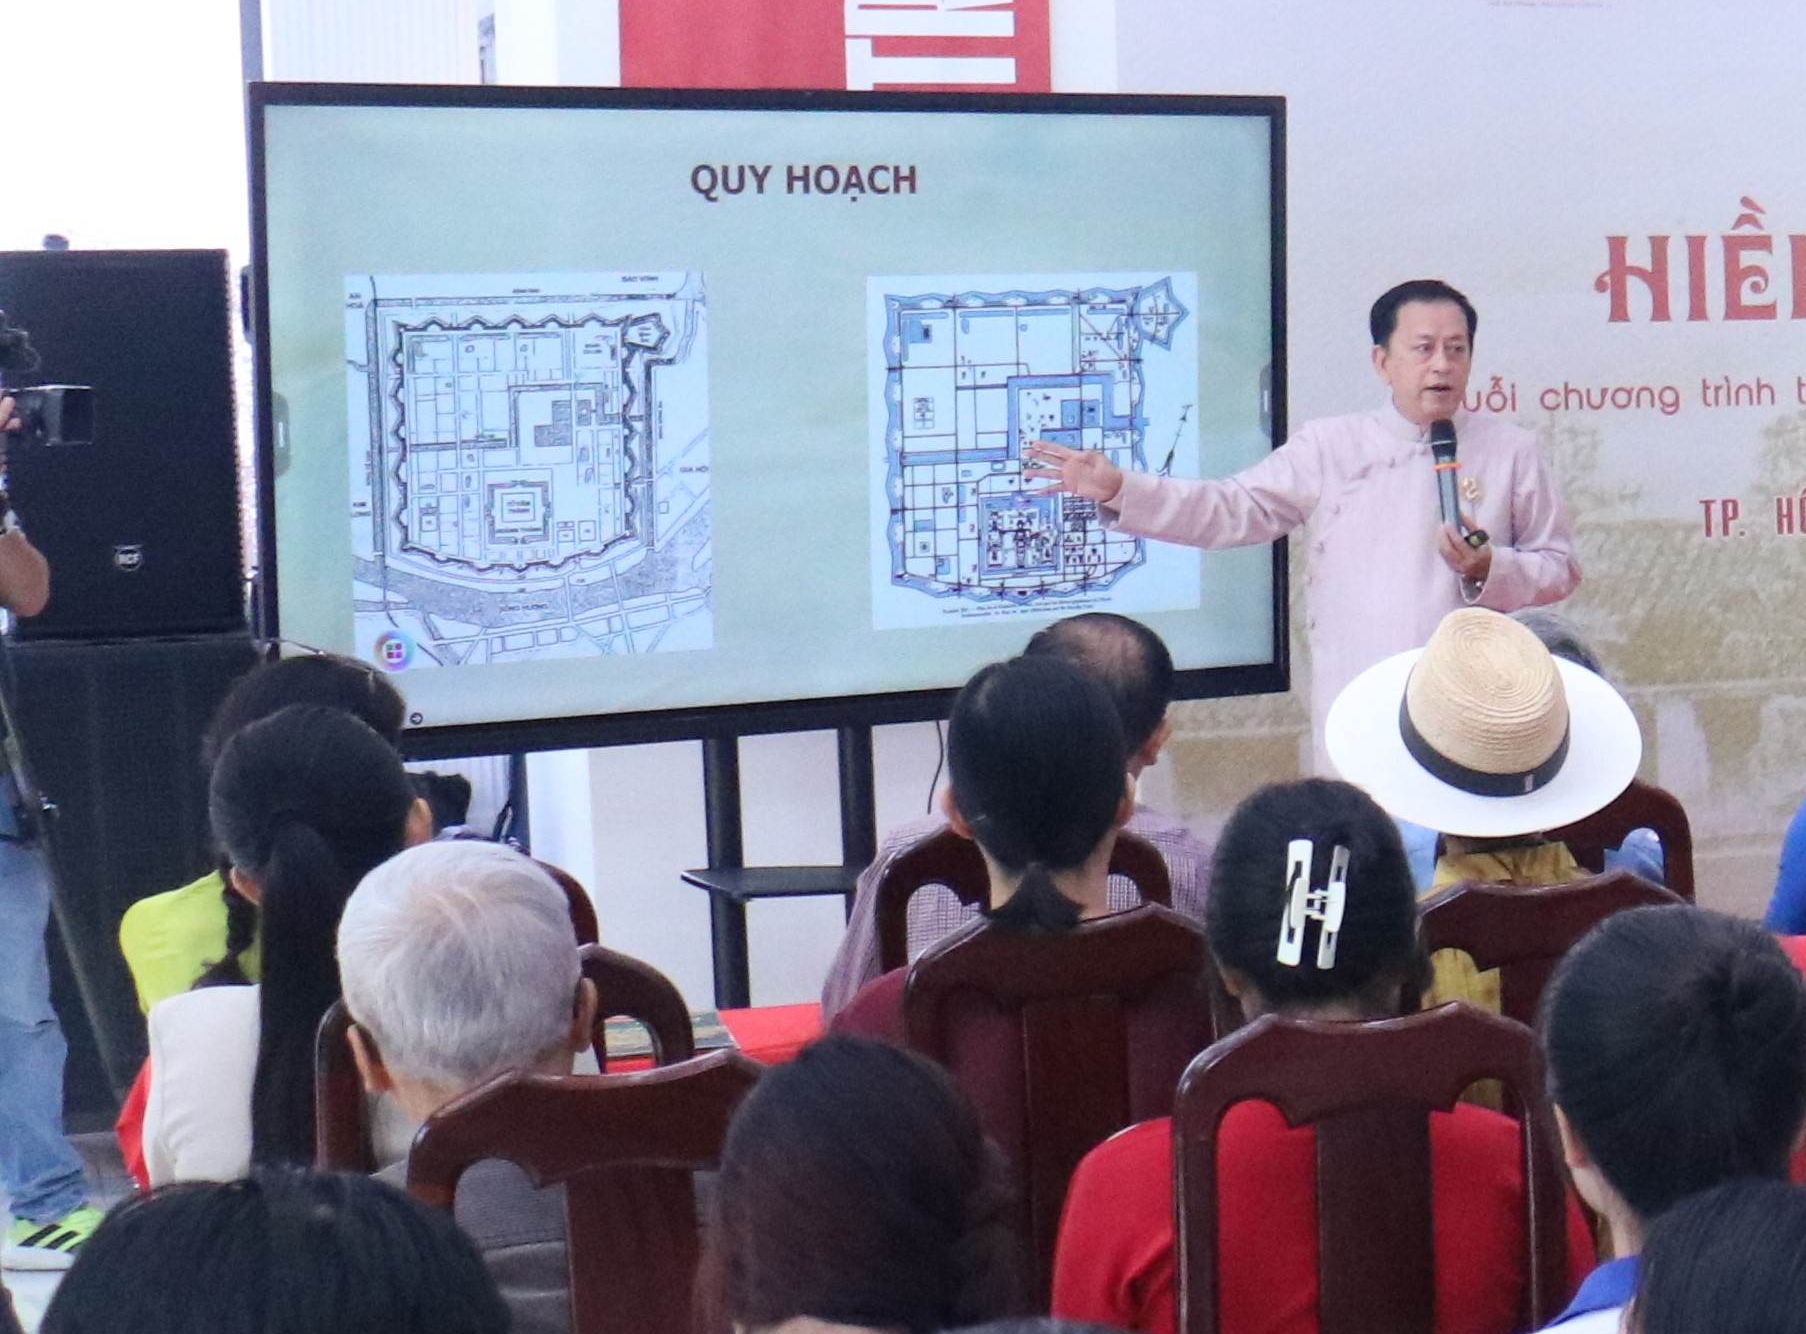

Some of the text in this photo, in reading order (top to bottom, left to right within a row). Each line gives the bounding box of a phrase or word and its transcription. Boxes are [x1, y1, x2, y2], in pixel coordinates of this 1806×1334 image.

[690, 163, 917, 203] QUY HOẠCH
[1461, 376, 1517, 413] uỗi
[1540, 382, 1680, 415] chương
[1701, 375, 1775, 407] trình
[1699, 498, 1745, 537] TP.
